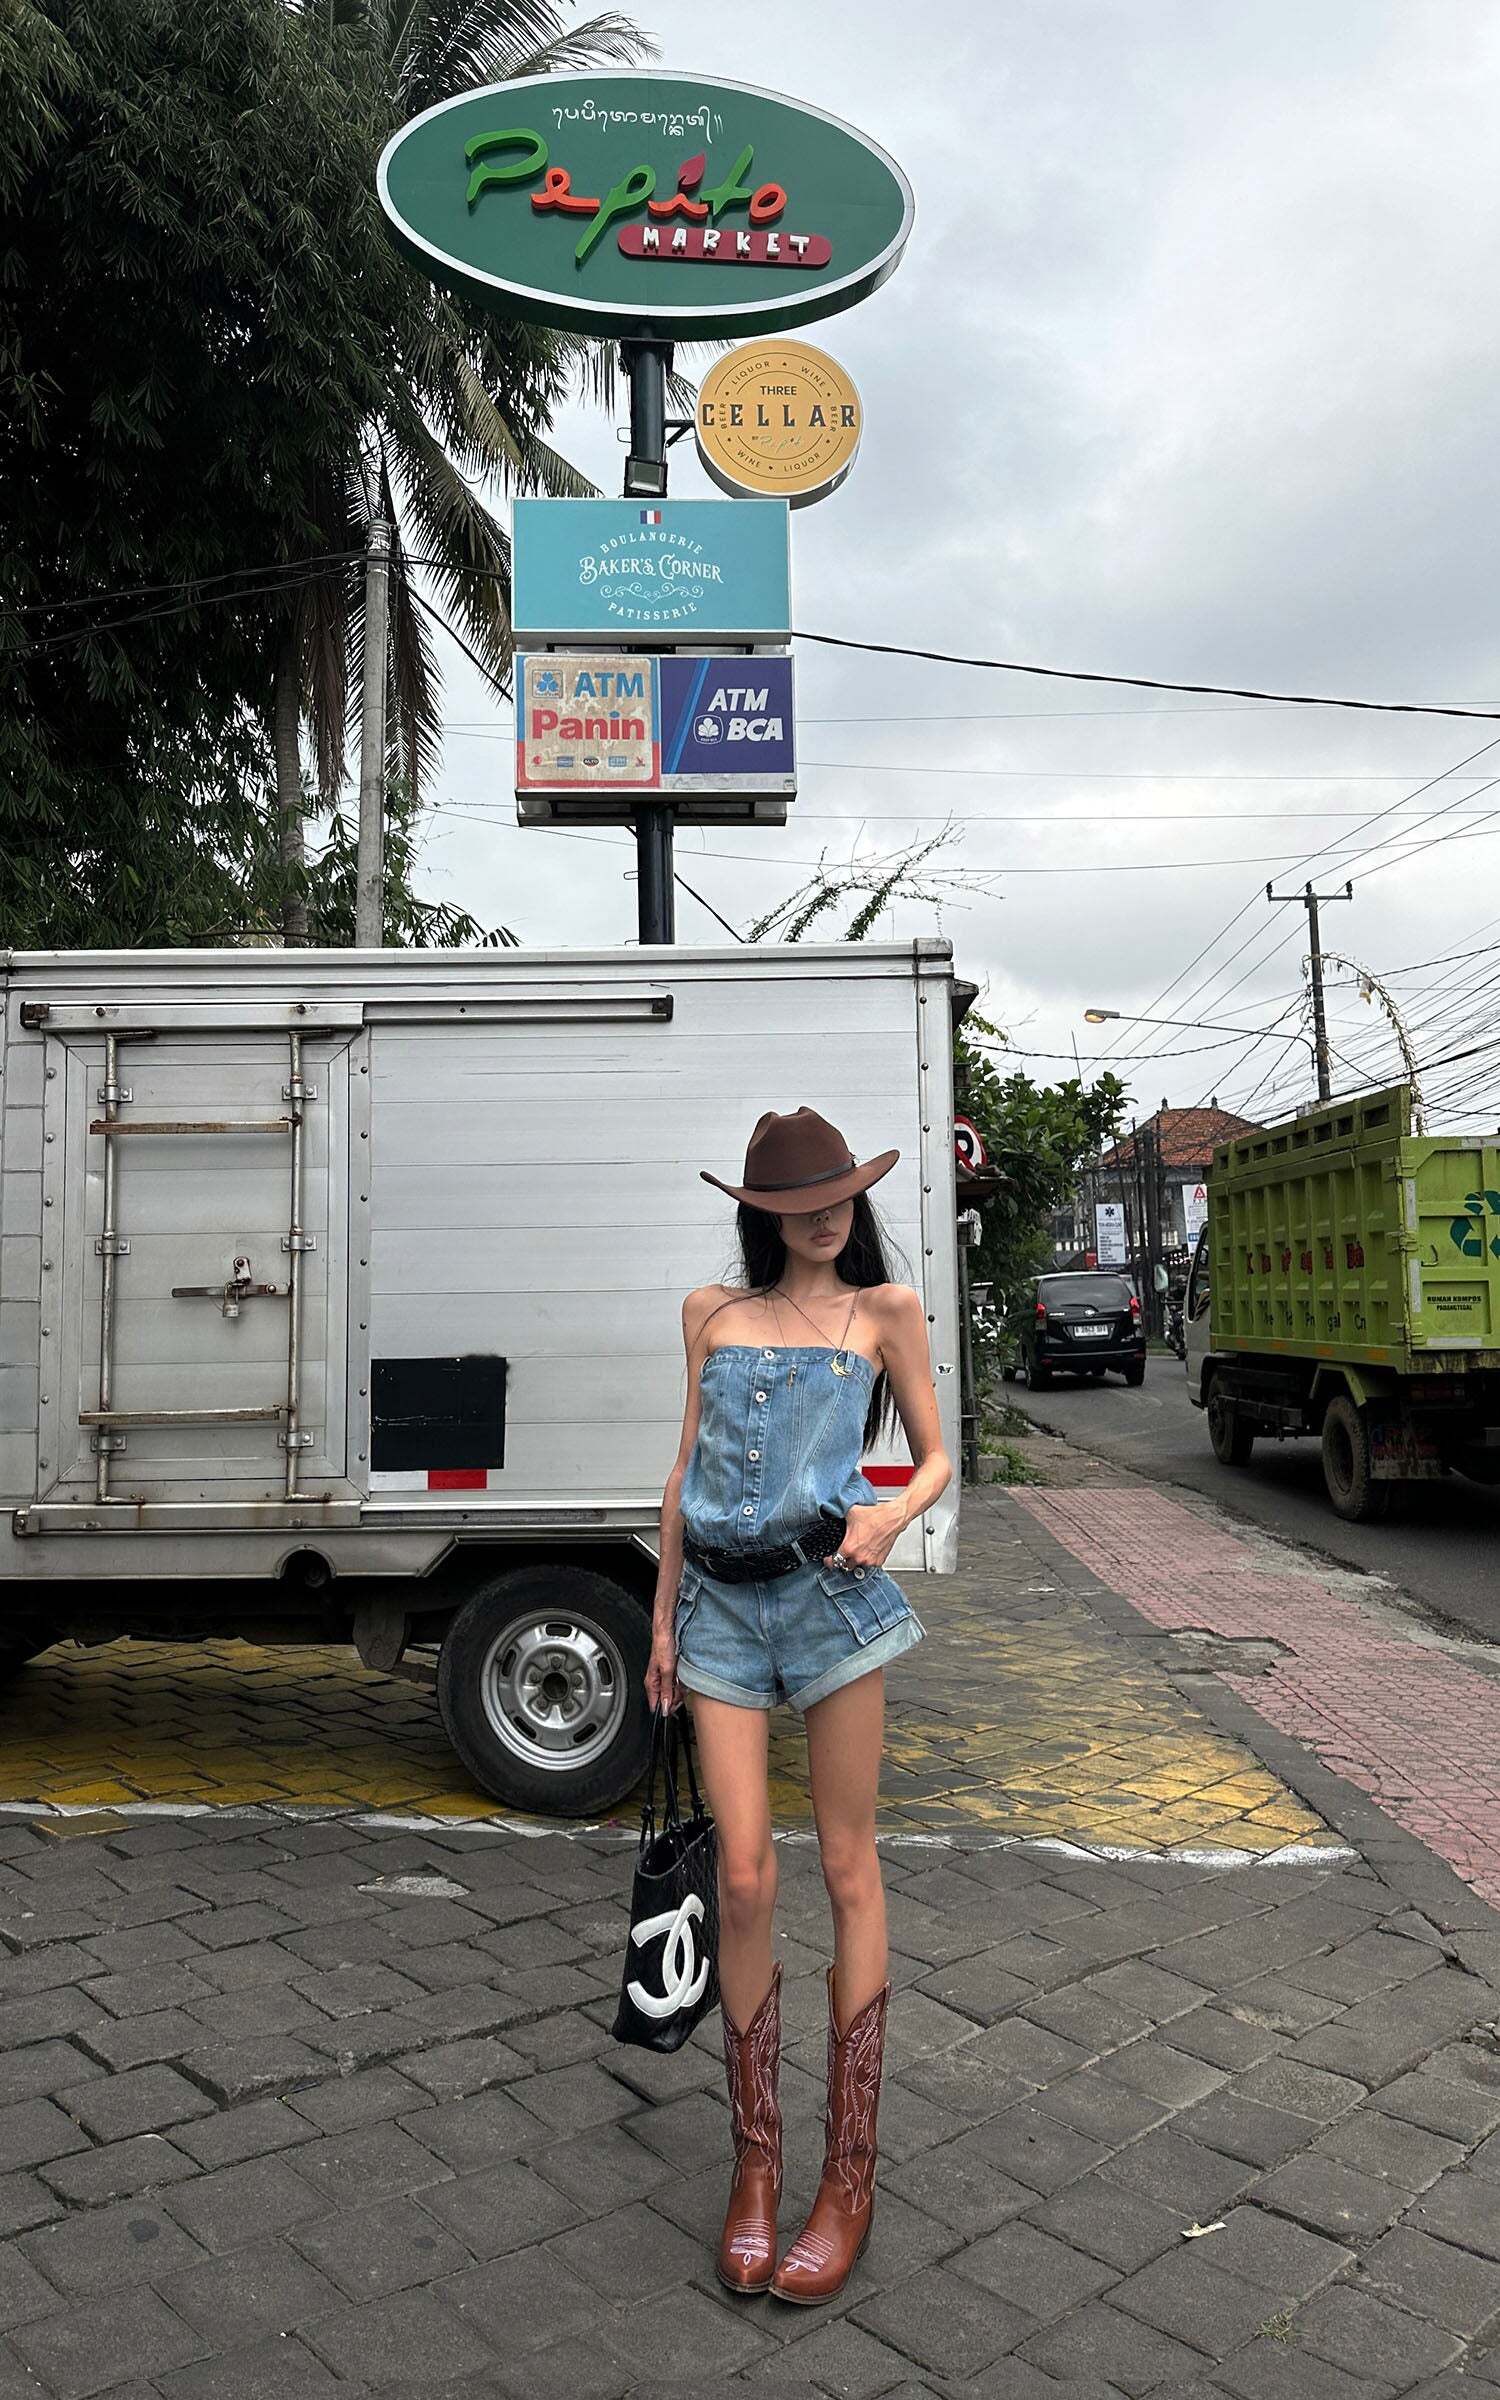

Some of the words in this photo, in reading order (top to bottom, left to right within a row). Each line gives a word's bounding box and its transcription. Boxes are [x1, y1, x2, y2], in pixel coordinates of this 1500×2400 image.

[464, 128, 787, 267] Pepito
[643, 226, 811, 256] MARKET
[731, 361, 770, 385] LIQUOR
[801, 366, 826, 388] WINE
[760, 385, 797, 396] THREE
[702, 403, 856, 428] CELLAR
[719, 403, 727, 430] BEER
[830, 406, 838, 433] BEER
[737, 449, 760, 469] WINE
[784, 452, 820, 472] LIQUOR
[600, 532, 702, 554] BOULANGERIE
[658, 553, 724, 583] CORNER
[608, 602, 697, 620] PATISSERIE
[574, 672, 645, 698] ATM
[708, 688, 769, 711] ATM
[532, 709, 645, 740] Panin
[726, 717, 783, 741] BCA
